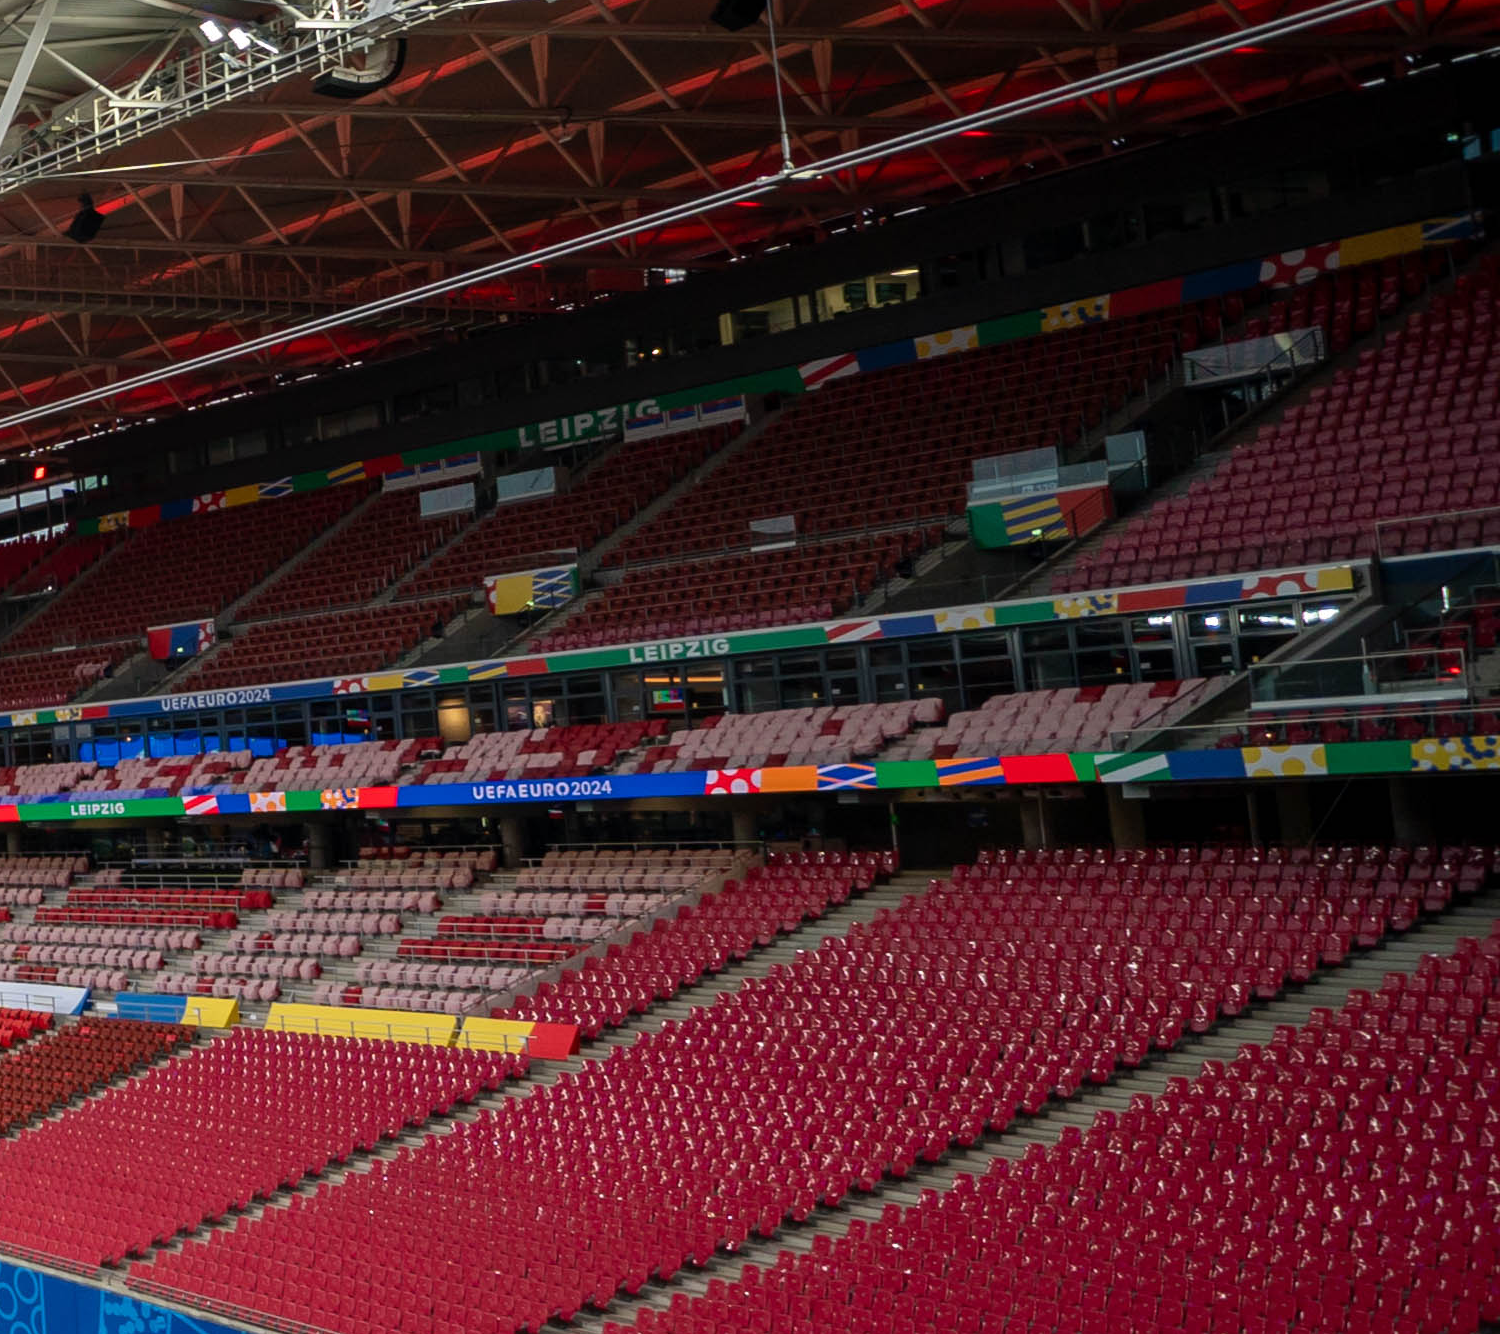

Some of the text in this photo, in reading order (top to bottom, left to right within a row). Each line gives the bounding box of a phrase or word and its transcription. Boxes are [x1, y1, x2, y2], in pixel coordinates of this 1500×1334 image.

[518, 398, 660, 448] LEIPZIG
[629, 638, 730, 663] LEIPZIG
[70, 802, 125, 816] LEIPZIG
